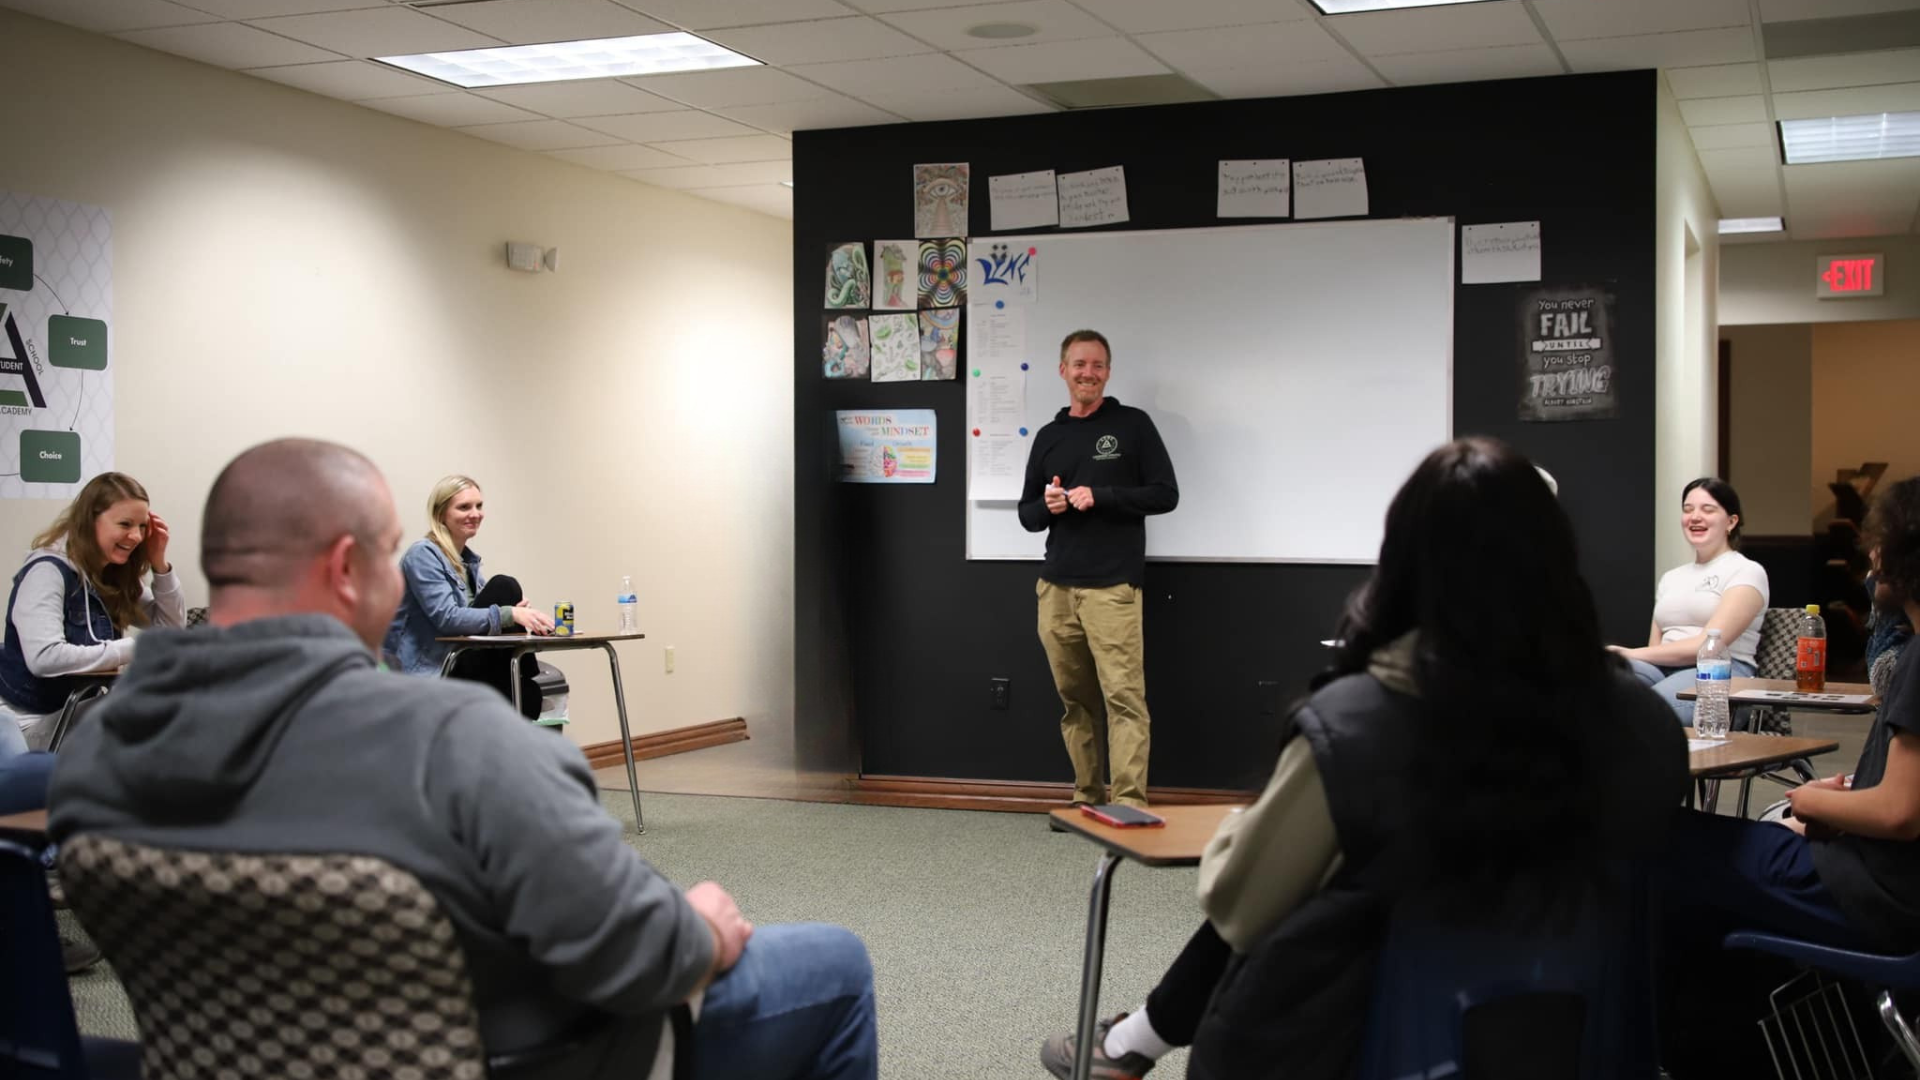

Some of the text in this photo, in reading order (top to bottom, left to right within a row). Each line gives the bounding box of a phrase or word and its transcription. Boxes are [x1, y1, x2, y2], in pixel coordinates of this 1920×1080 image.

[1830, 258, 1875, 291] EXIT
[1539, 299, 1594, 310] You never
[1540, 311, 1592, 337] FAIL
[70, 337, 87, 346] Trust
[1549, 341, 1584, 349] UNTIL
[25, 338, 45, 375] SCHOOL
[1544, 352, 1591, 368] you stop
[1530, 365, 1611, 397] TRYING
[39, 450, 62, 460] Choice
